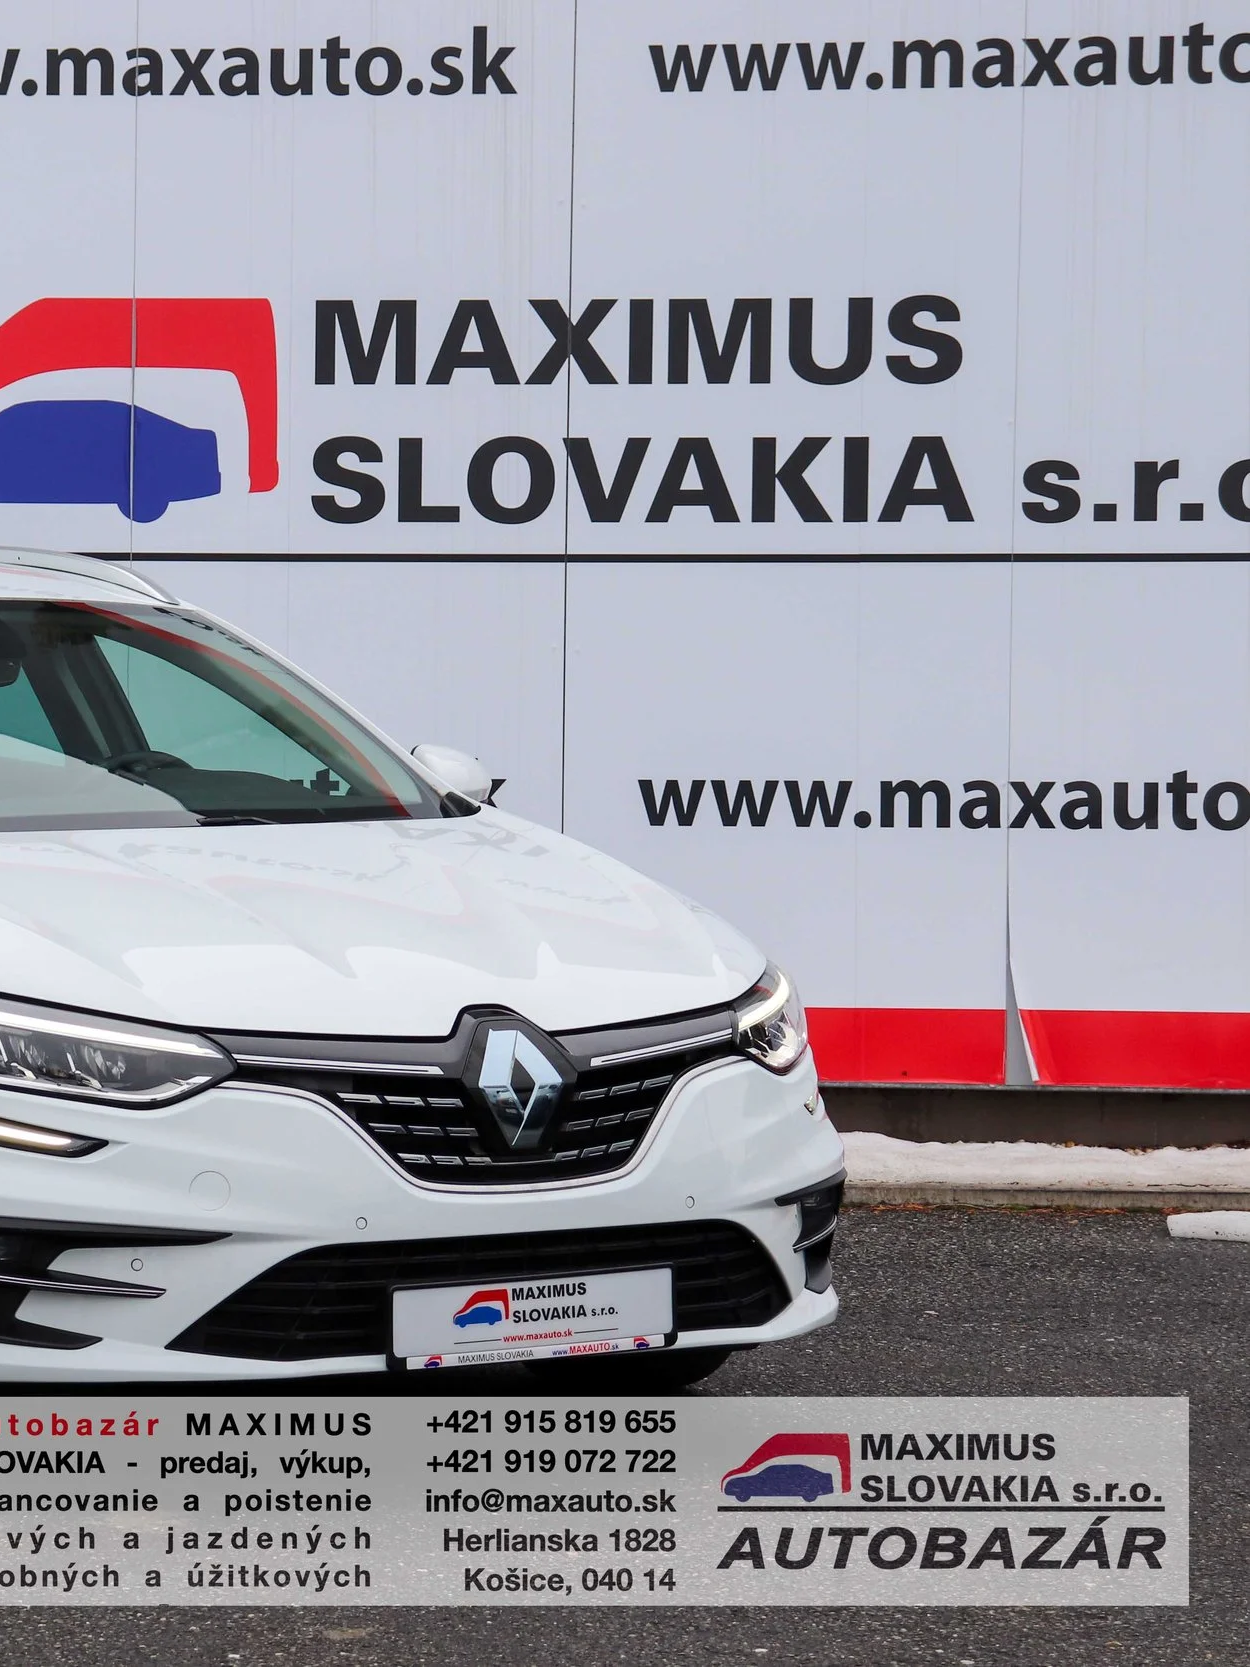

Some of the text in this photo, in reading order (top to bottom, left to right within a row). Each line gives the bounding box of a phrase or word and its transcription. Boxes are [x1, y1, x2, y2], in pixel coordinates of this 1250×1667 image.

[315, 295, 963, 386] MAXIMUS
[312, 436, 974, 524] SLOVAKIA
[511, 1282, 587, 1302] MAXIMUS
[513, 1305, 619, 1324] SLOVAKIA s.r.o.
[503, 1328, 573, 1343] www.maxauto.sk
[457, 1342, 620, 1364] MAXIMUS SLOVAKIA www.MAXAUTO.sk
